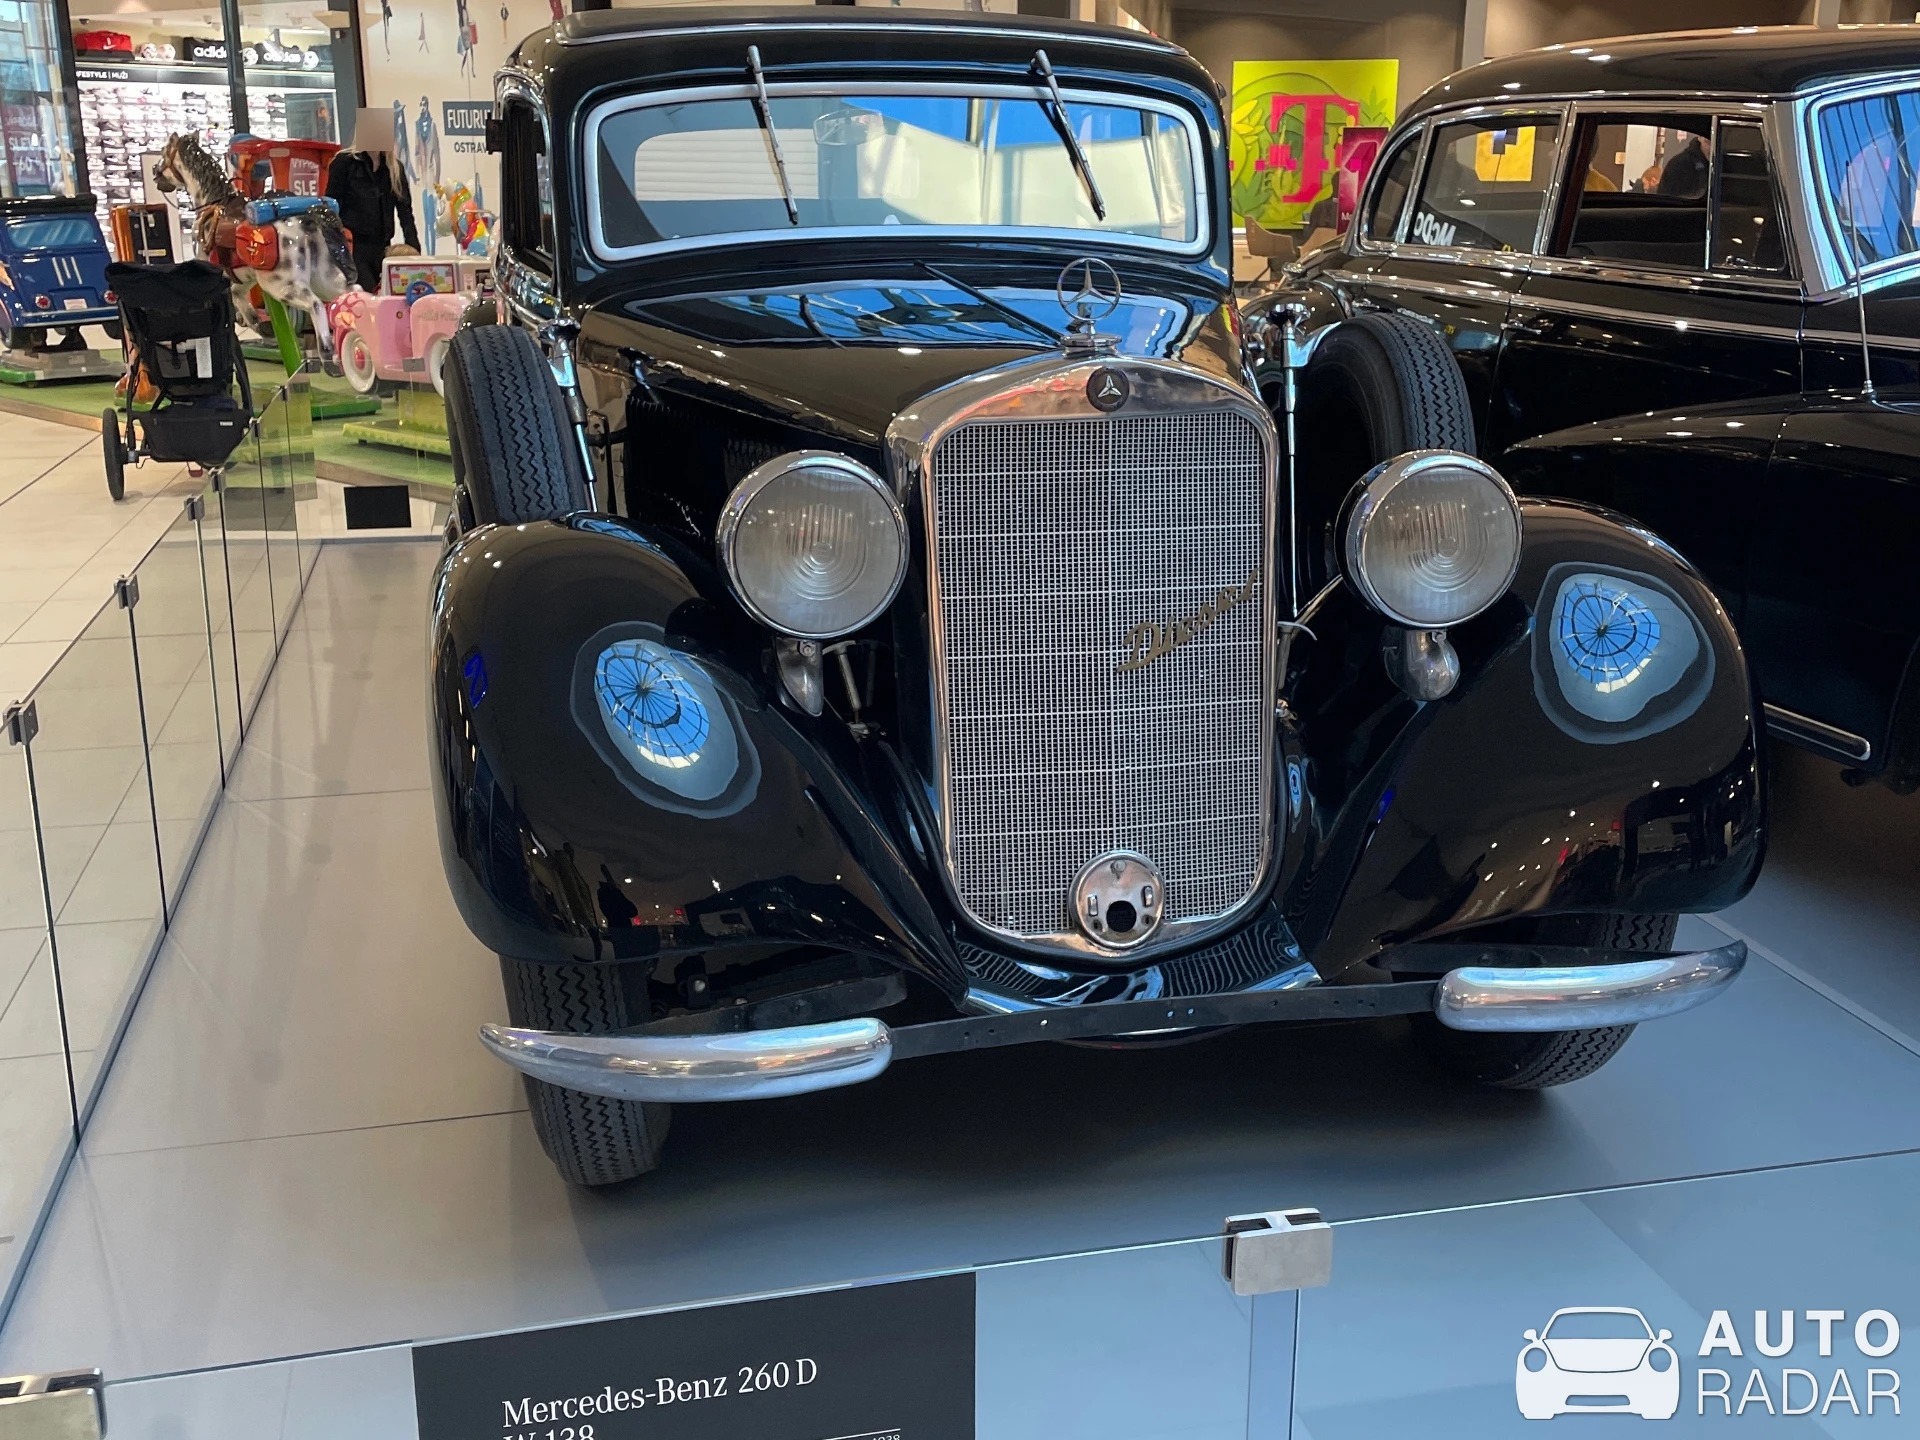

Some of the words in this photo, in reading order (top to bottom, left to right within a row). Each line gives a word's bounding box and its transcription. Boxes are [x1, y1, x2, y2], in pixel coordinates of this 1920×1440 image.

[447, 108, 490, 129] FUTURU
[1116, 567, 1259, 673] Diesel
[502, 1376, 728, 1428] Mercedes-Benz
[738, 1362, 790, 1394] 260
[795, 1358, 817, 1386] D
